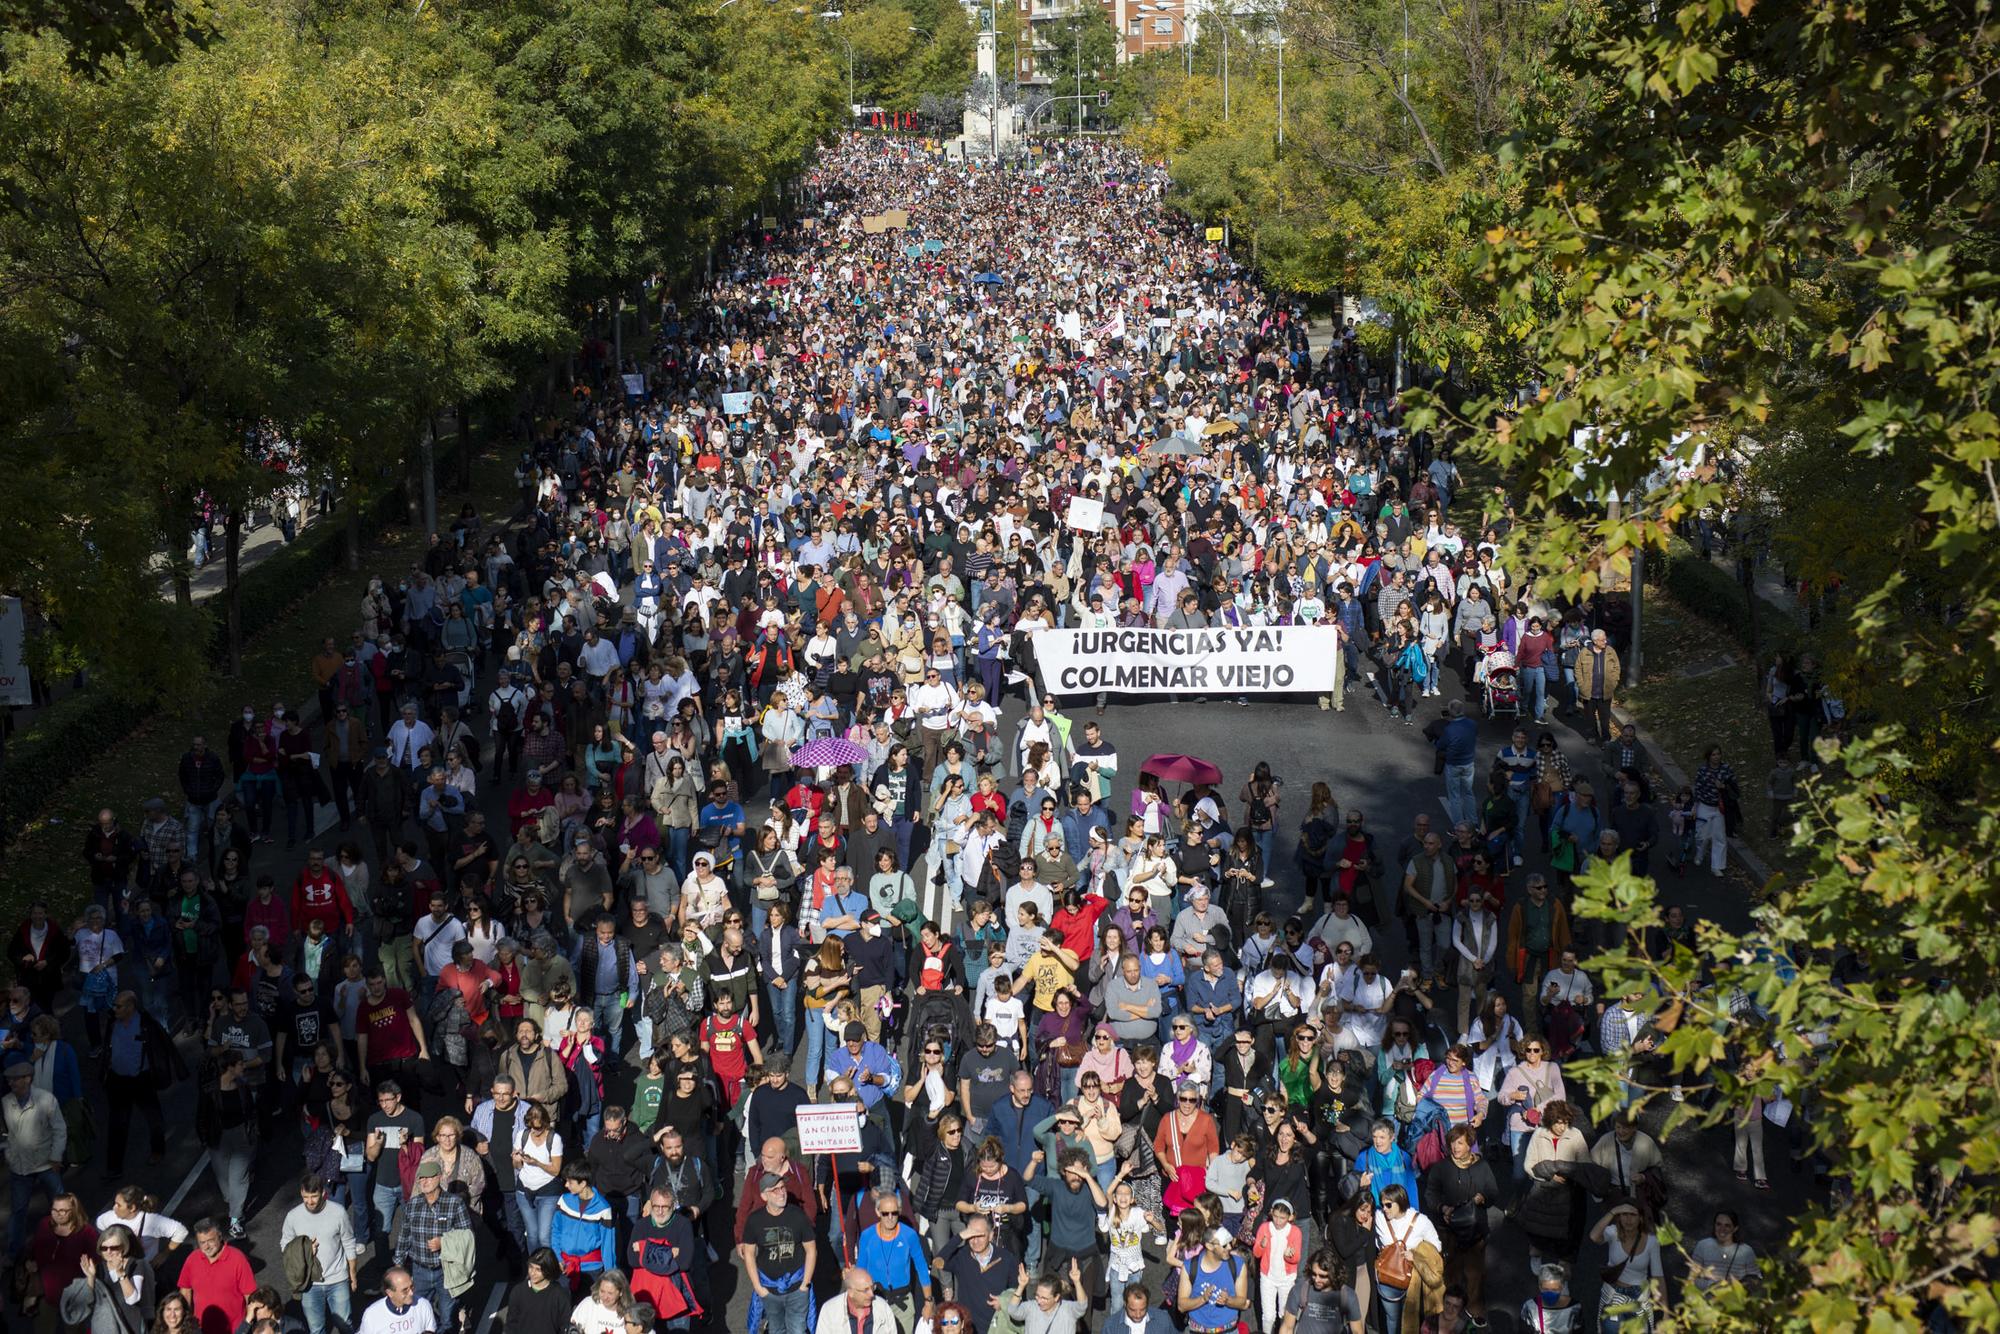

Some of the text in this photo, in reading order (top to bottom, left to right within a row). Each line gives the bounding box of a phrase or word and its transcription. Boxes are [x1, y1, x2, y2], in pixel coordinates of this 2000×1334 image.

[1072, 630, 1283, 656] ¡URGENCIAS YA!
[1060, 664, 1294, 690] COLMENAR VIEJO
[804, 1125, 855, 1134] ANCIANOS
[804, 1138, 857, 1146] SANITARIOS
[389, 1317, 415, 1334] STOP
